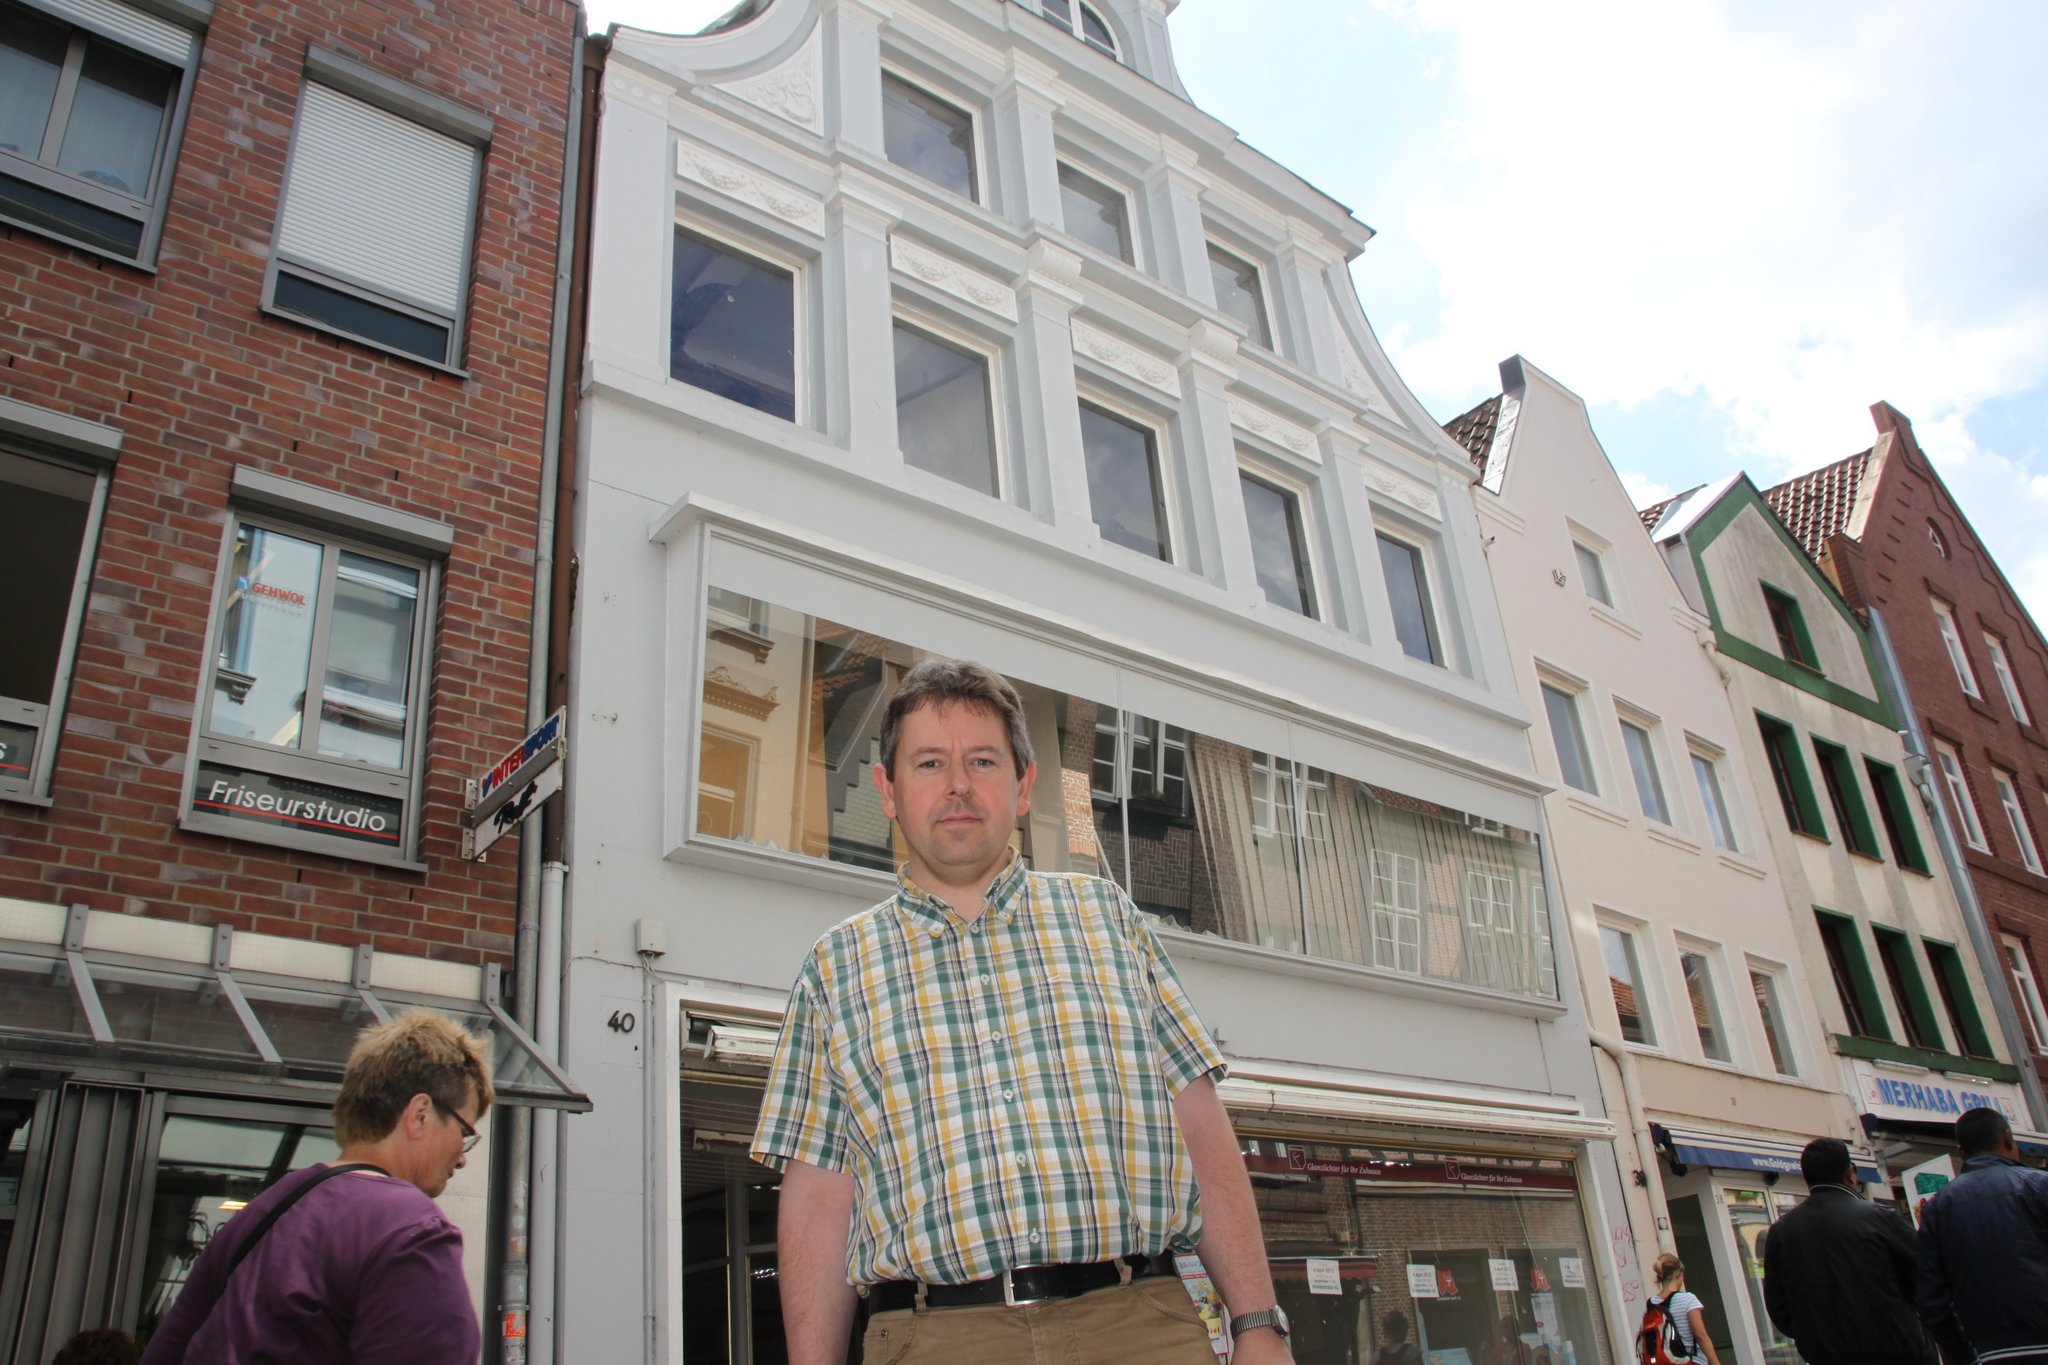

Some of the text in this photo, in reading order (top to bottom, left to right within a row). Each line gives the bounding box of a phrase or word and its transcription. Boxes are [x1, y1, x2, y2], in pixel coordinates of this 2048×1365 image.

[251, 582, 306, 606] GEHWOL
[208, 780, 386, 832] Friseurstudio
[607, 1010, 636, 1033] 40
[1876, 1077, 1961, 1115] MERHABA
